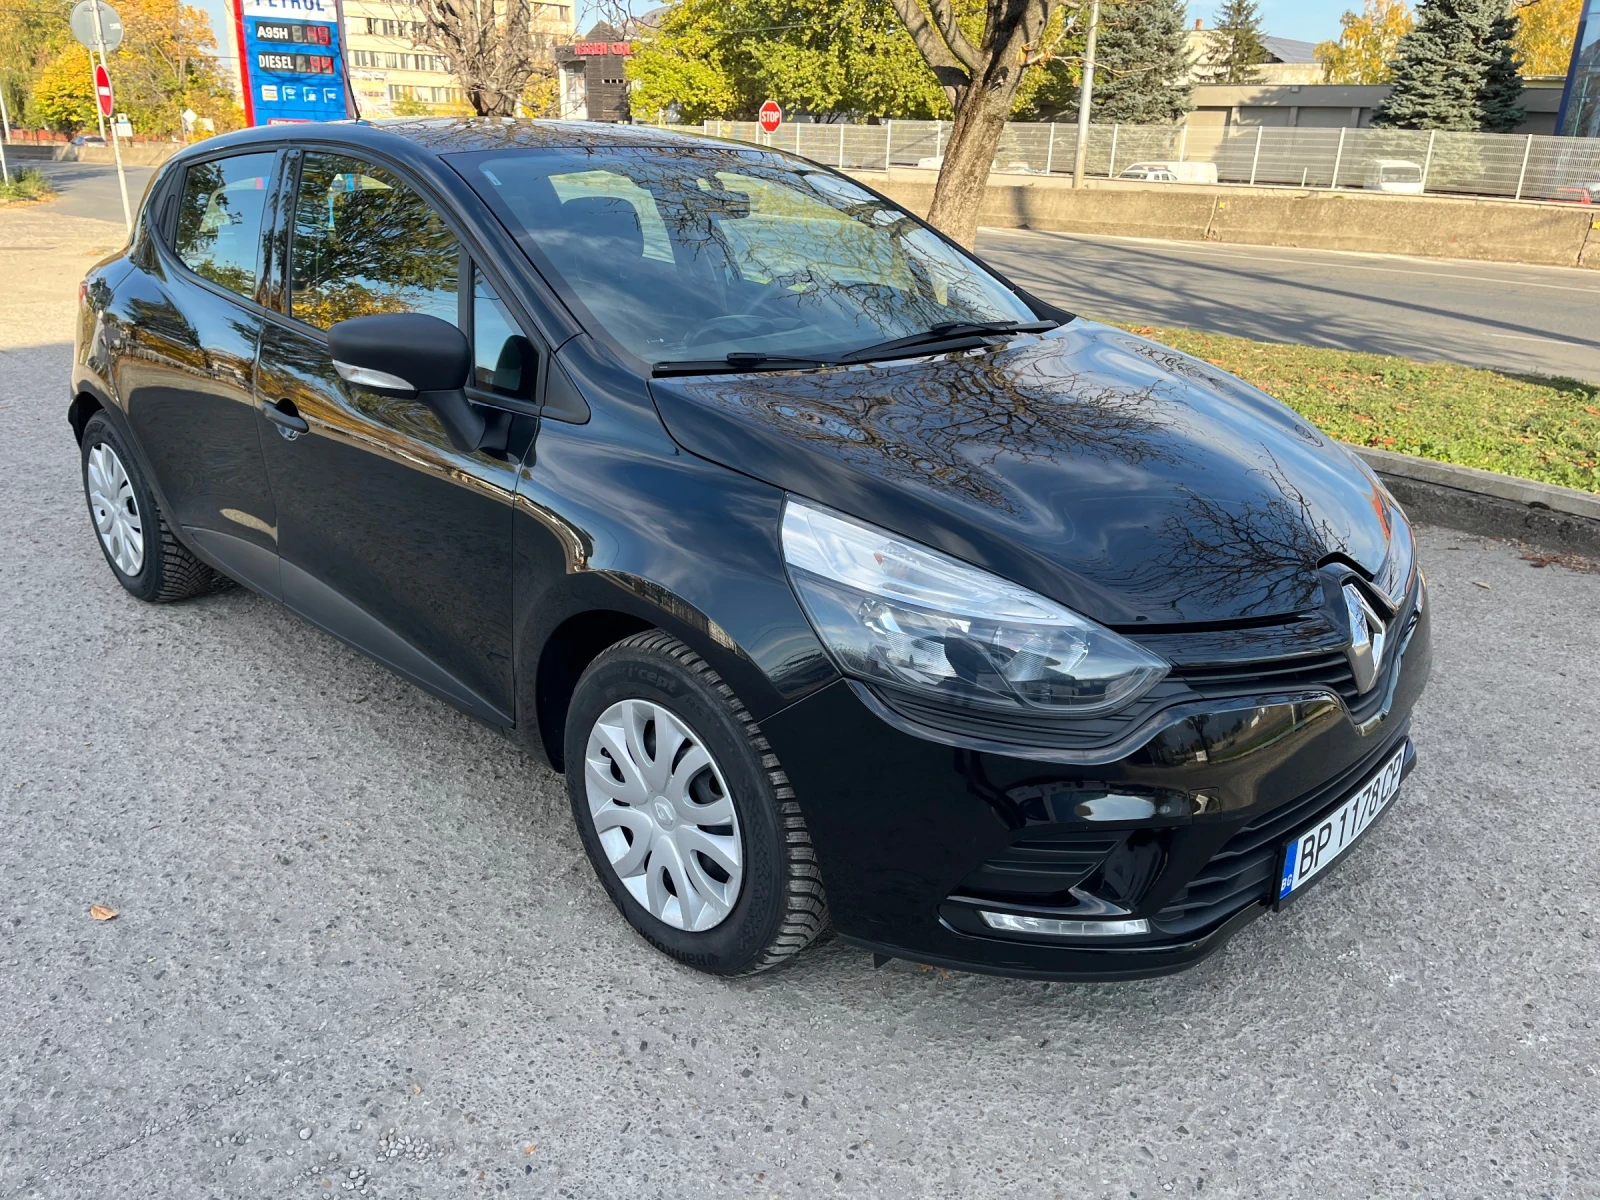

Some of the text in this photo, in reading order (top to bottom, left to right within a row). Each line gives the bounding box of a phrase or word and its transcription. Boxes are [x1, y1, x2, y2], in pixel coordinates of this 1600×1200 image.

[258, 54, 294, 70] DIESEL
[761, 111, 780, 123] STOP
[1298, 821, 1332, 881] BP
[1280, 873, 1293, 892] BG
